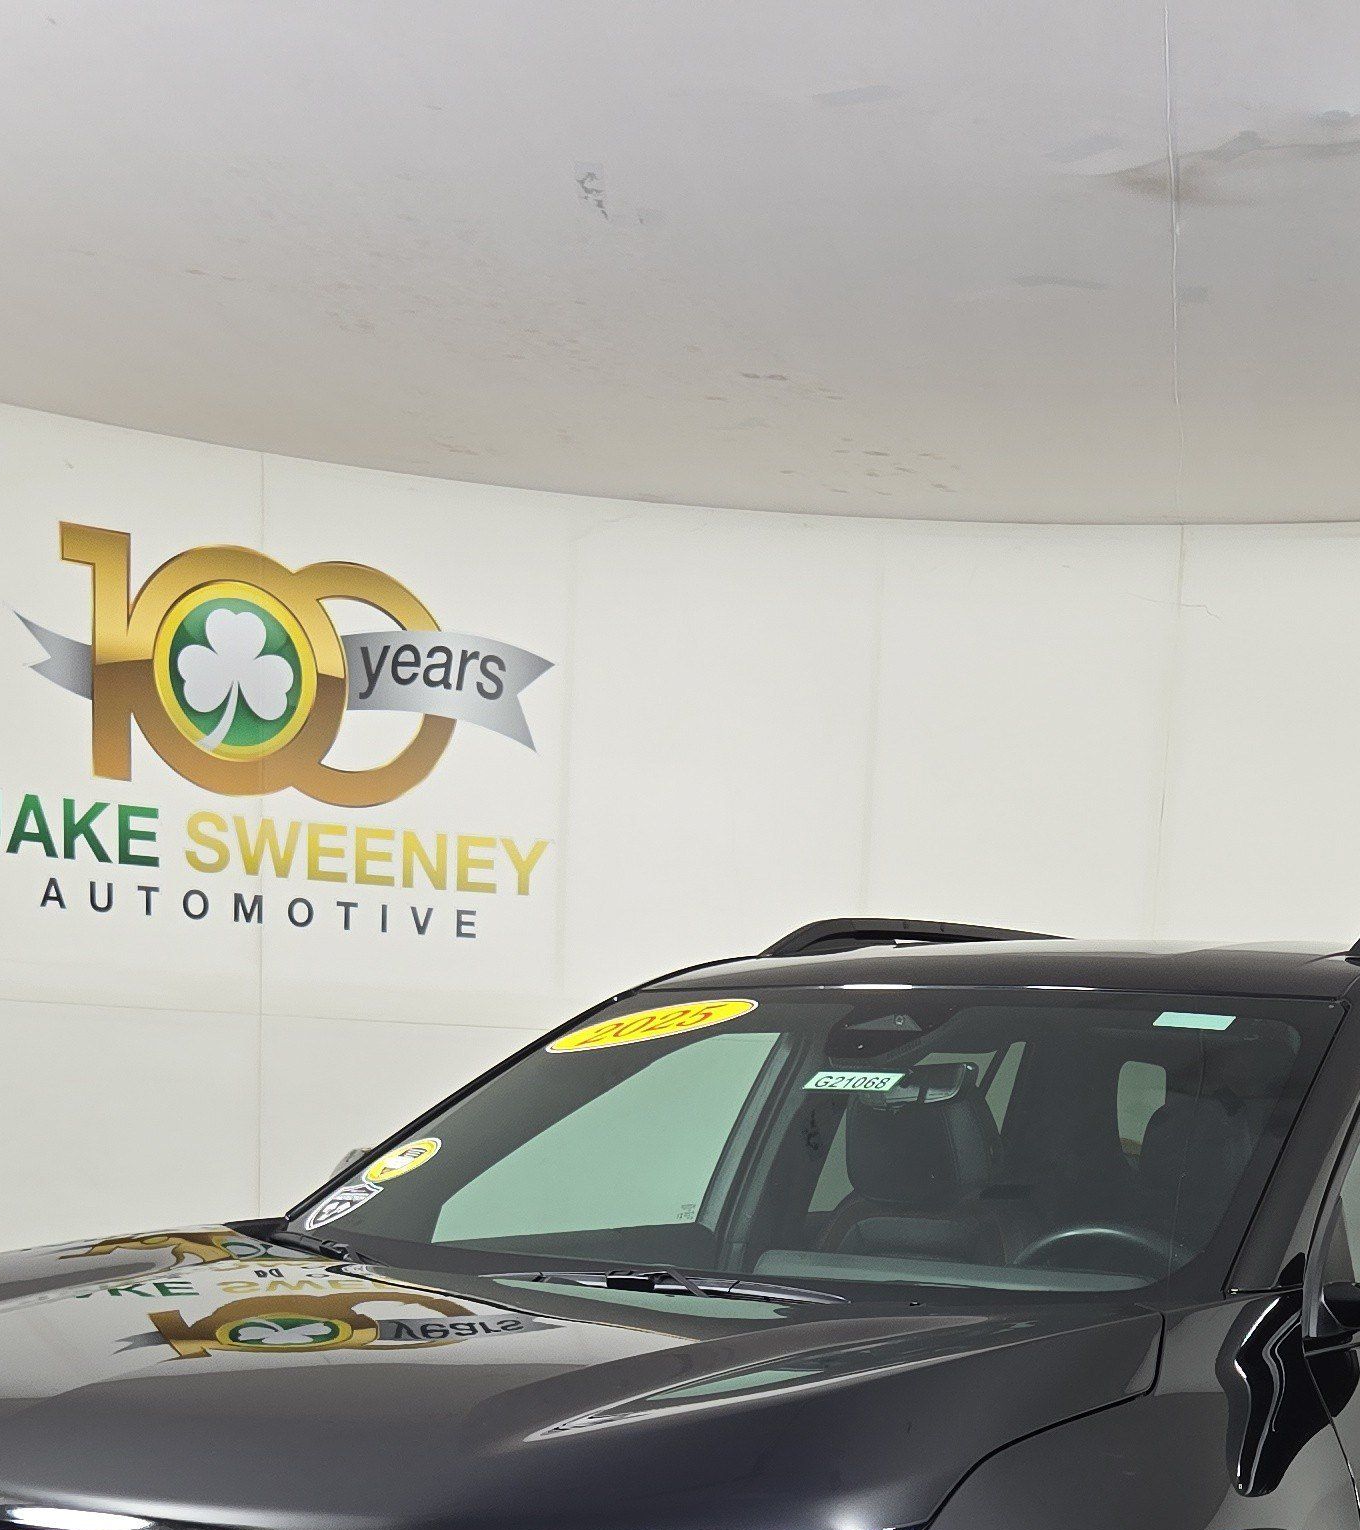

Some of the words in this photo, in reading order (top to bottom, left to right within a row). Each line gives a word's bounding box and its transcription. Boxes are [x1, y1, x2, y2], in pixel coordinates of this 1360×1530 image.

[59, 521, 457, 808] 100
[358, 645, 506, 700] years
[184, 811, 549, 896] SWEENEY
[40, 877, 477, 938] AUTOMOTIVE
[579, 1003, 728, 1045] 2025
[814, 1075, 891, 1089] G21068
